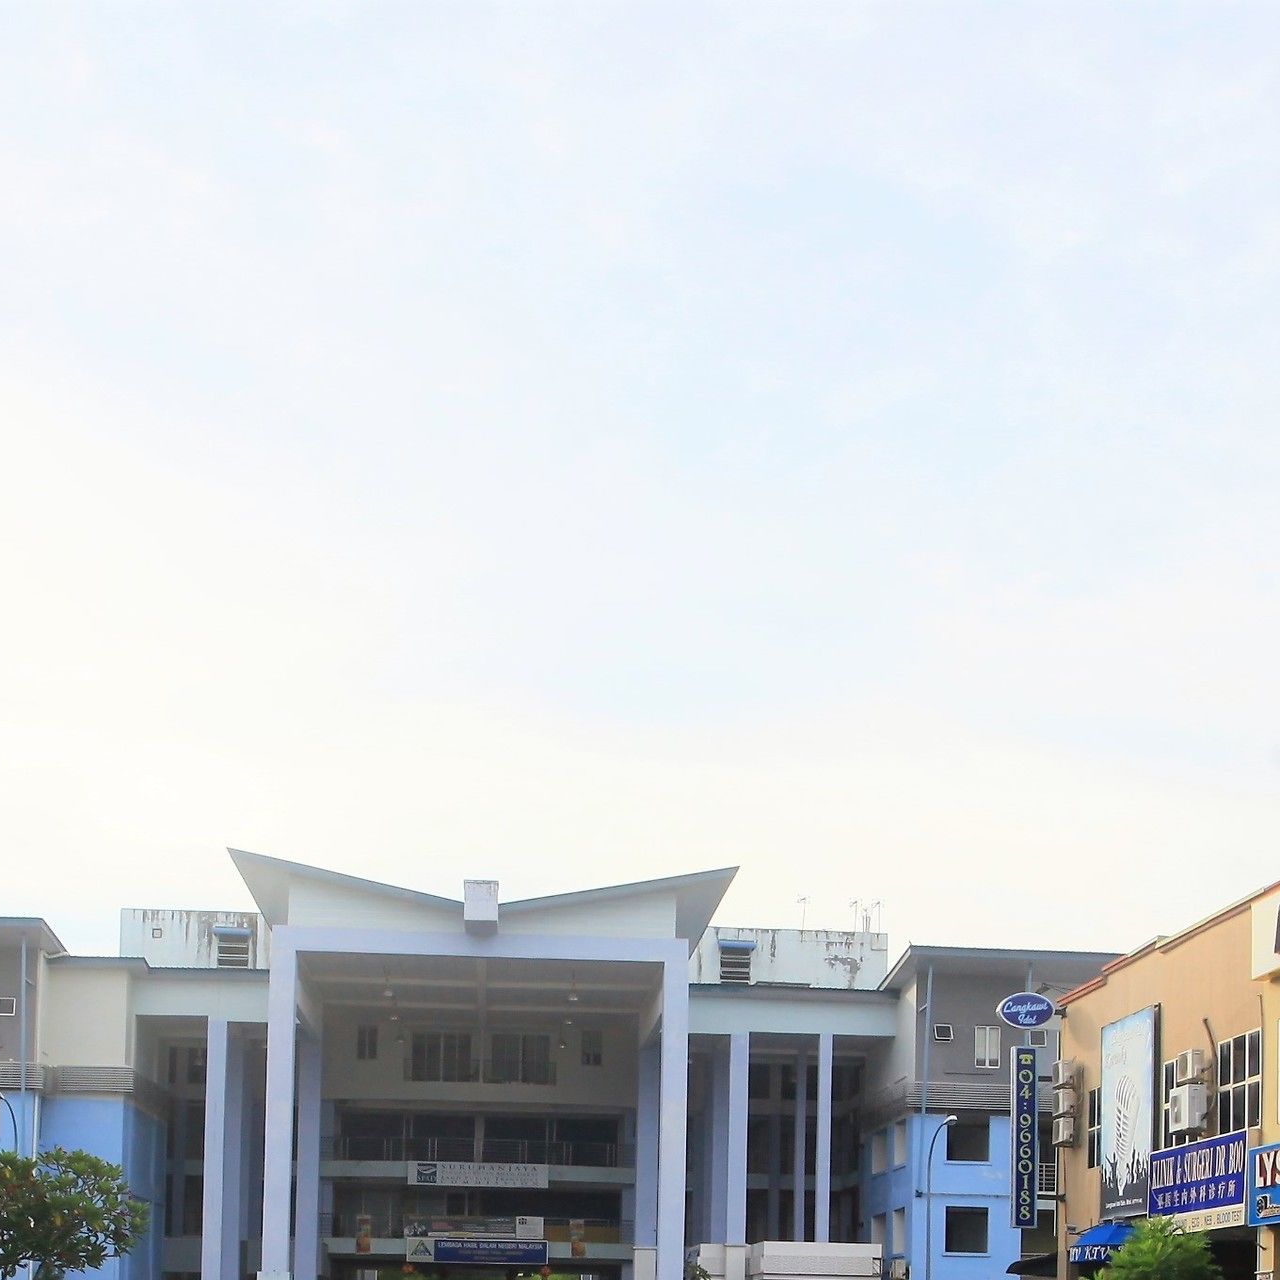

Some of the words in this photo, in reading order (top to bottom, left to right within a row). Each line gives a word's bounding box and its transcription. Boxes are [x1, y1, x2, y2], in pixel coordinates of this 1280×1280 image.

[1003, 1001, 1049, 1017] Langkawi
[1017, 1013, 1037, 1024] Idol
[1151, 1156, 1175, 1189] KLINIK
[1184, 1147, 1214, 1183] SURGERI
[1215, 1144, 1226, 1177] DR
[1228, 1140, 1245, 1174] BOO
[1085, 1245, 1110, 1260] KTV
